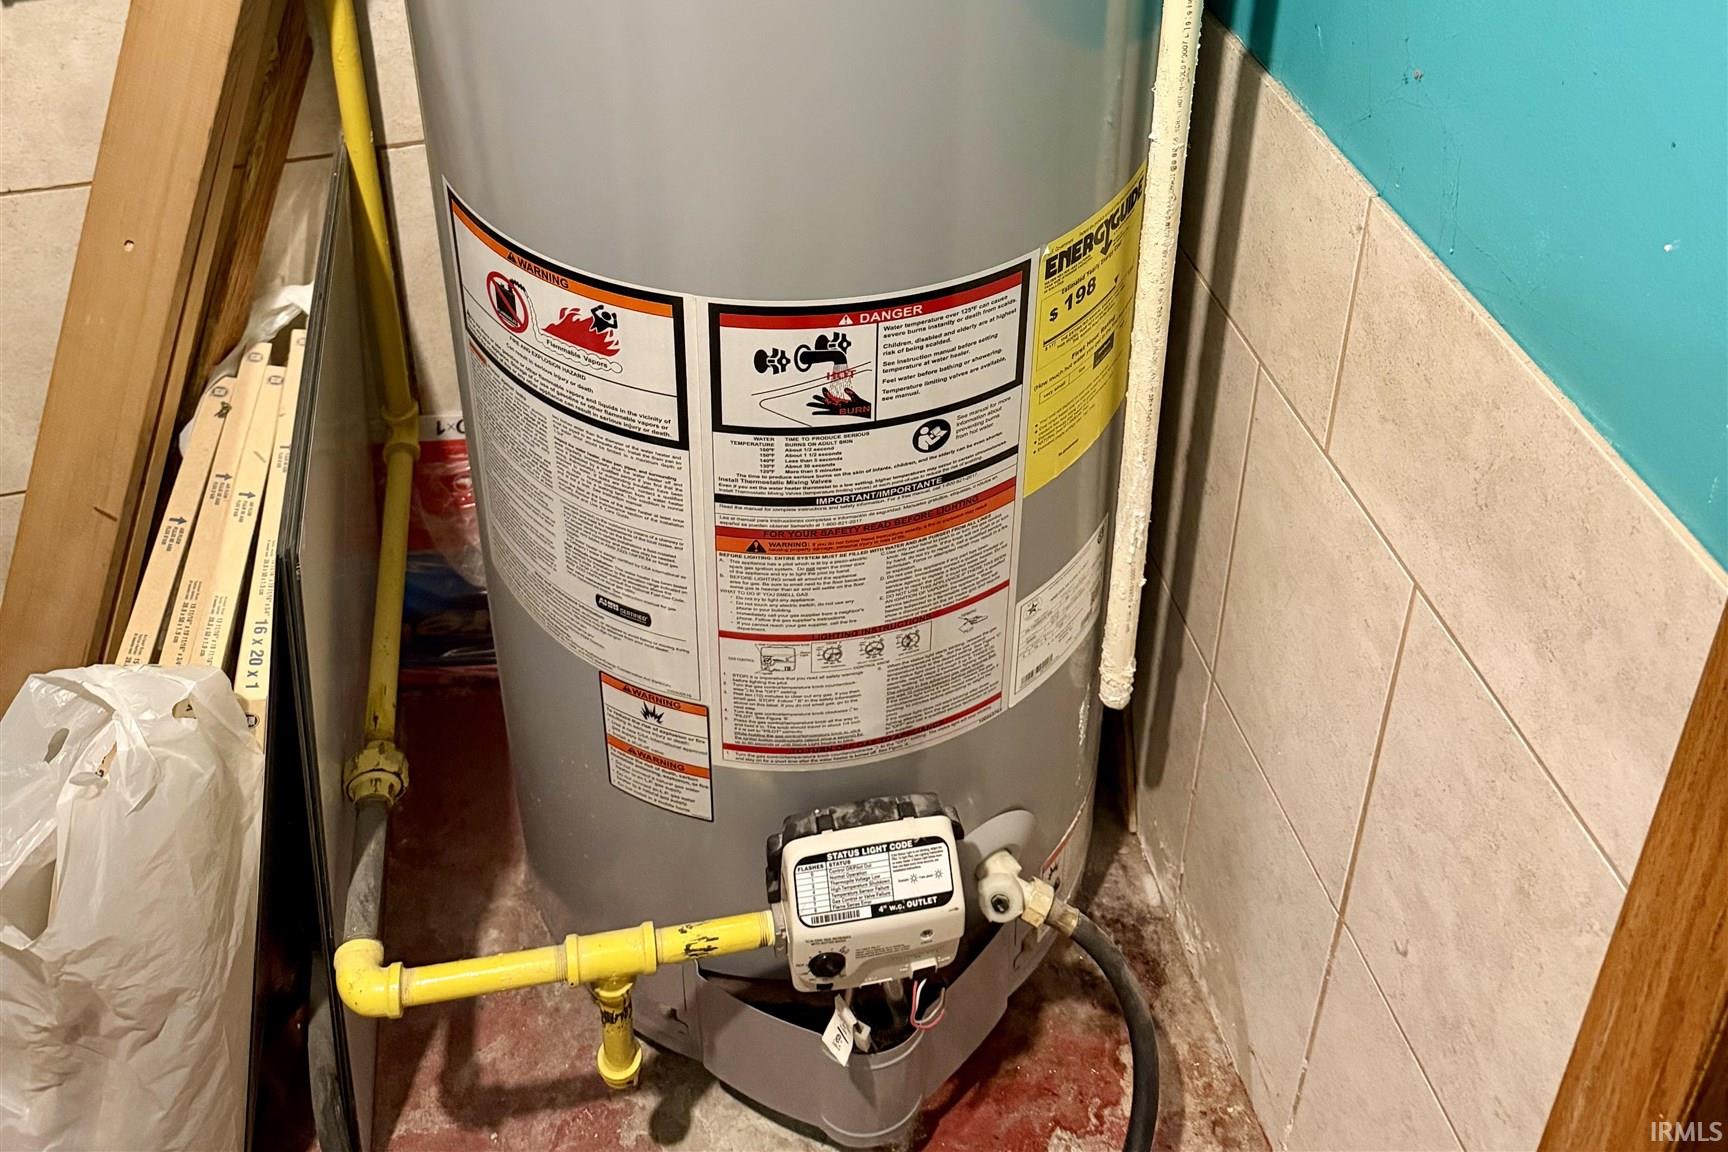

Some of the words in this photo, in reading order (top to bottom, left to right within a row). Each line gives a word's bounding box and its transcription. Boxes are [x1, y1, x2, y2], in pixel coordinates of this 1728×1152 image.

[1045, 175, 1144, 280] ENERGYGUIDE
[517, 257, 569, 288] WARNING
[1049, 307, 1059, 323] $
[1064, 276, 1097, 310] 198
[860, 305, 923, 323] DANGER
[883, 324, 904, 332] Water
[904, 314, 944, 329] temperature
[945, 312, 959, 320] over
[991, 295, 1008, 305] cause
[907, 327, 927, 335] burns
[928, 318, 956, 330] instantly
[964, 311, 982, 320] death
[982, 306, 996, 315] from
[883, 339, 914, 349] Children,
[914, 331, 943, 344] disabled
[957, 323, 977, 334] elderly
[996, 308, 1017, 320] highest
[546, 339, 581, 359] Flammable
[583, 355, 608, 368] Vapors
[897, 353, 932, 365] instruction
[933, 344, 957, 356] manual
[958, 340, 977, 350] before
[978, 333, 999, 344] setting
[905, 343, 924, 353] being
[926, 337, 952, 348] scalded.
[562, 365, 586, 380] HAZARD
[882, 362, 922, 374] temperature
[931, 355, 950, 364] water
[917, 368, 938, 378] before
[939, 362, 963, 373] bathing
[882, 382, 923, 395] Temperature
[924, 376, 948, 387] limiting
[949, 371, 969, 380] valves
[894, 390, 921, 399] manual.
[597, 400, 618, 412] liquids
[639, 413, 663, 424] vicinity
[604, 409, 636, 423] flammable
[637, 418, 660, 429] vapors
[839, 405, 871, 415] BURN
[600, 415, 622, 426] serious
[623, 421, 642, 432] injury
[740, 477, 785, 485] Thermostatic
[816, 477, 943, 505] IMPORTANT/IMPORTANTE
[788, 530, 817, 538] YOUR
[819, 525, 862, 537] SAFETY
[863, 520, 892, 532] READ
[894, 510, 931, 527] BEFORE
[936, 495, 979, 517] LIGHTING
[254, 618, 269, 635] 16
[248, 649, 265, 666] 20
[246, 670, 259, 678] x
[632, 688, 682, 710] WARNING
[637, 750, 686, 772] WARNING
[826, 849, 860, 861] STATUS
[861, 844, 888, 856] LIGHT
[889, 840, 913, 851] CODE
[797, 864, 824, 872] FLASHES
[828, 860, 851, 868] STATUS
[906, 896, 938, 908] OUTLET
